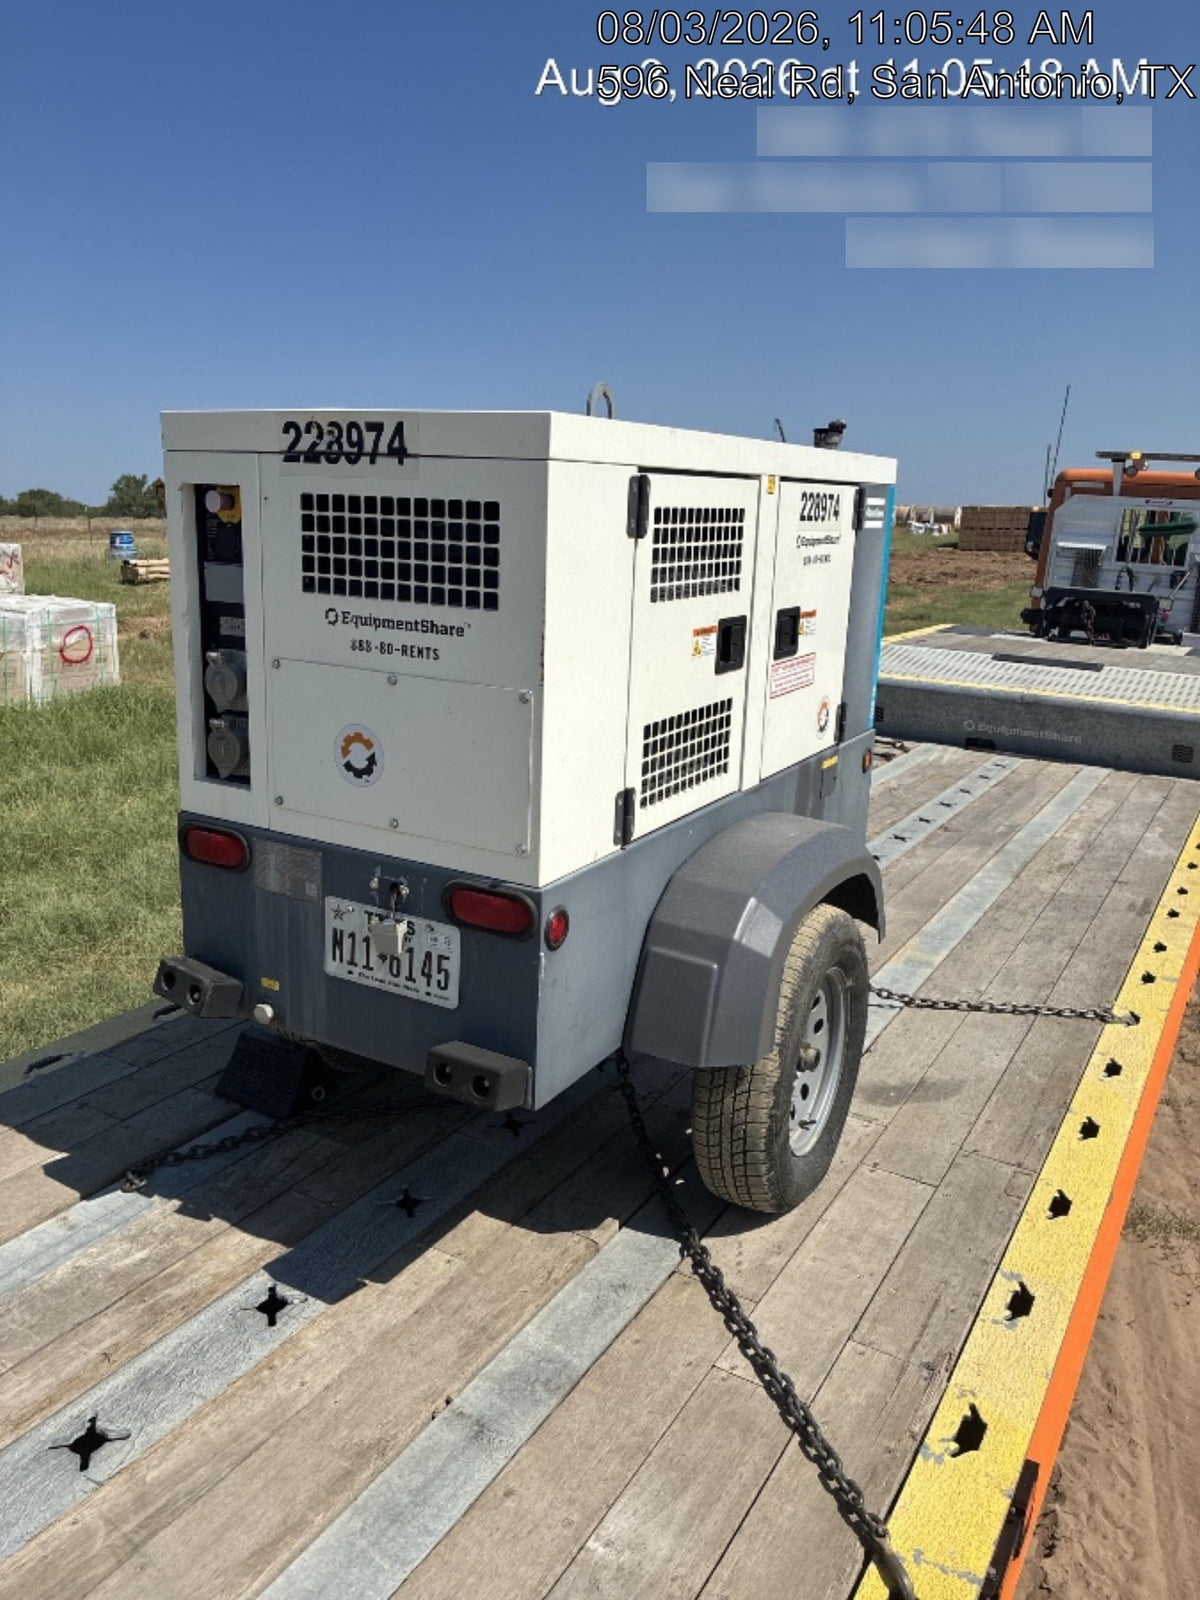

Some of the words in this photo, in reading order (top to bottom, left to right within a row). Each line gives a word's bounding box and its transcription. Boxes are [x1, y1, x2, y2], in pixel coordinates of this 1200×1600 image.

[282, 420, 408, 466] 228974
[800, 492, 840, 522] 228974
[341, 610, 465, 638] EquipmentShare
